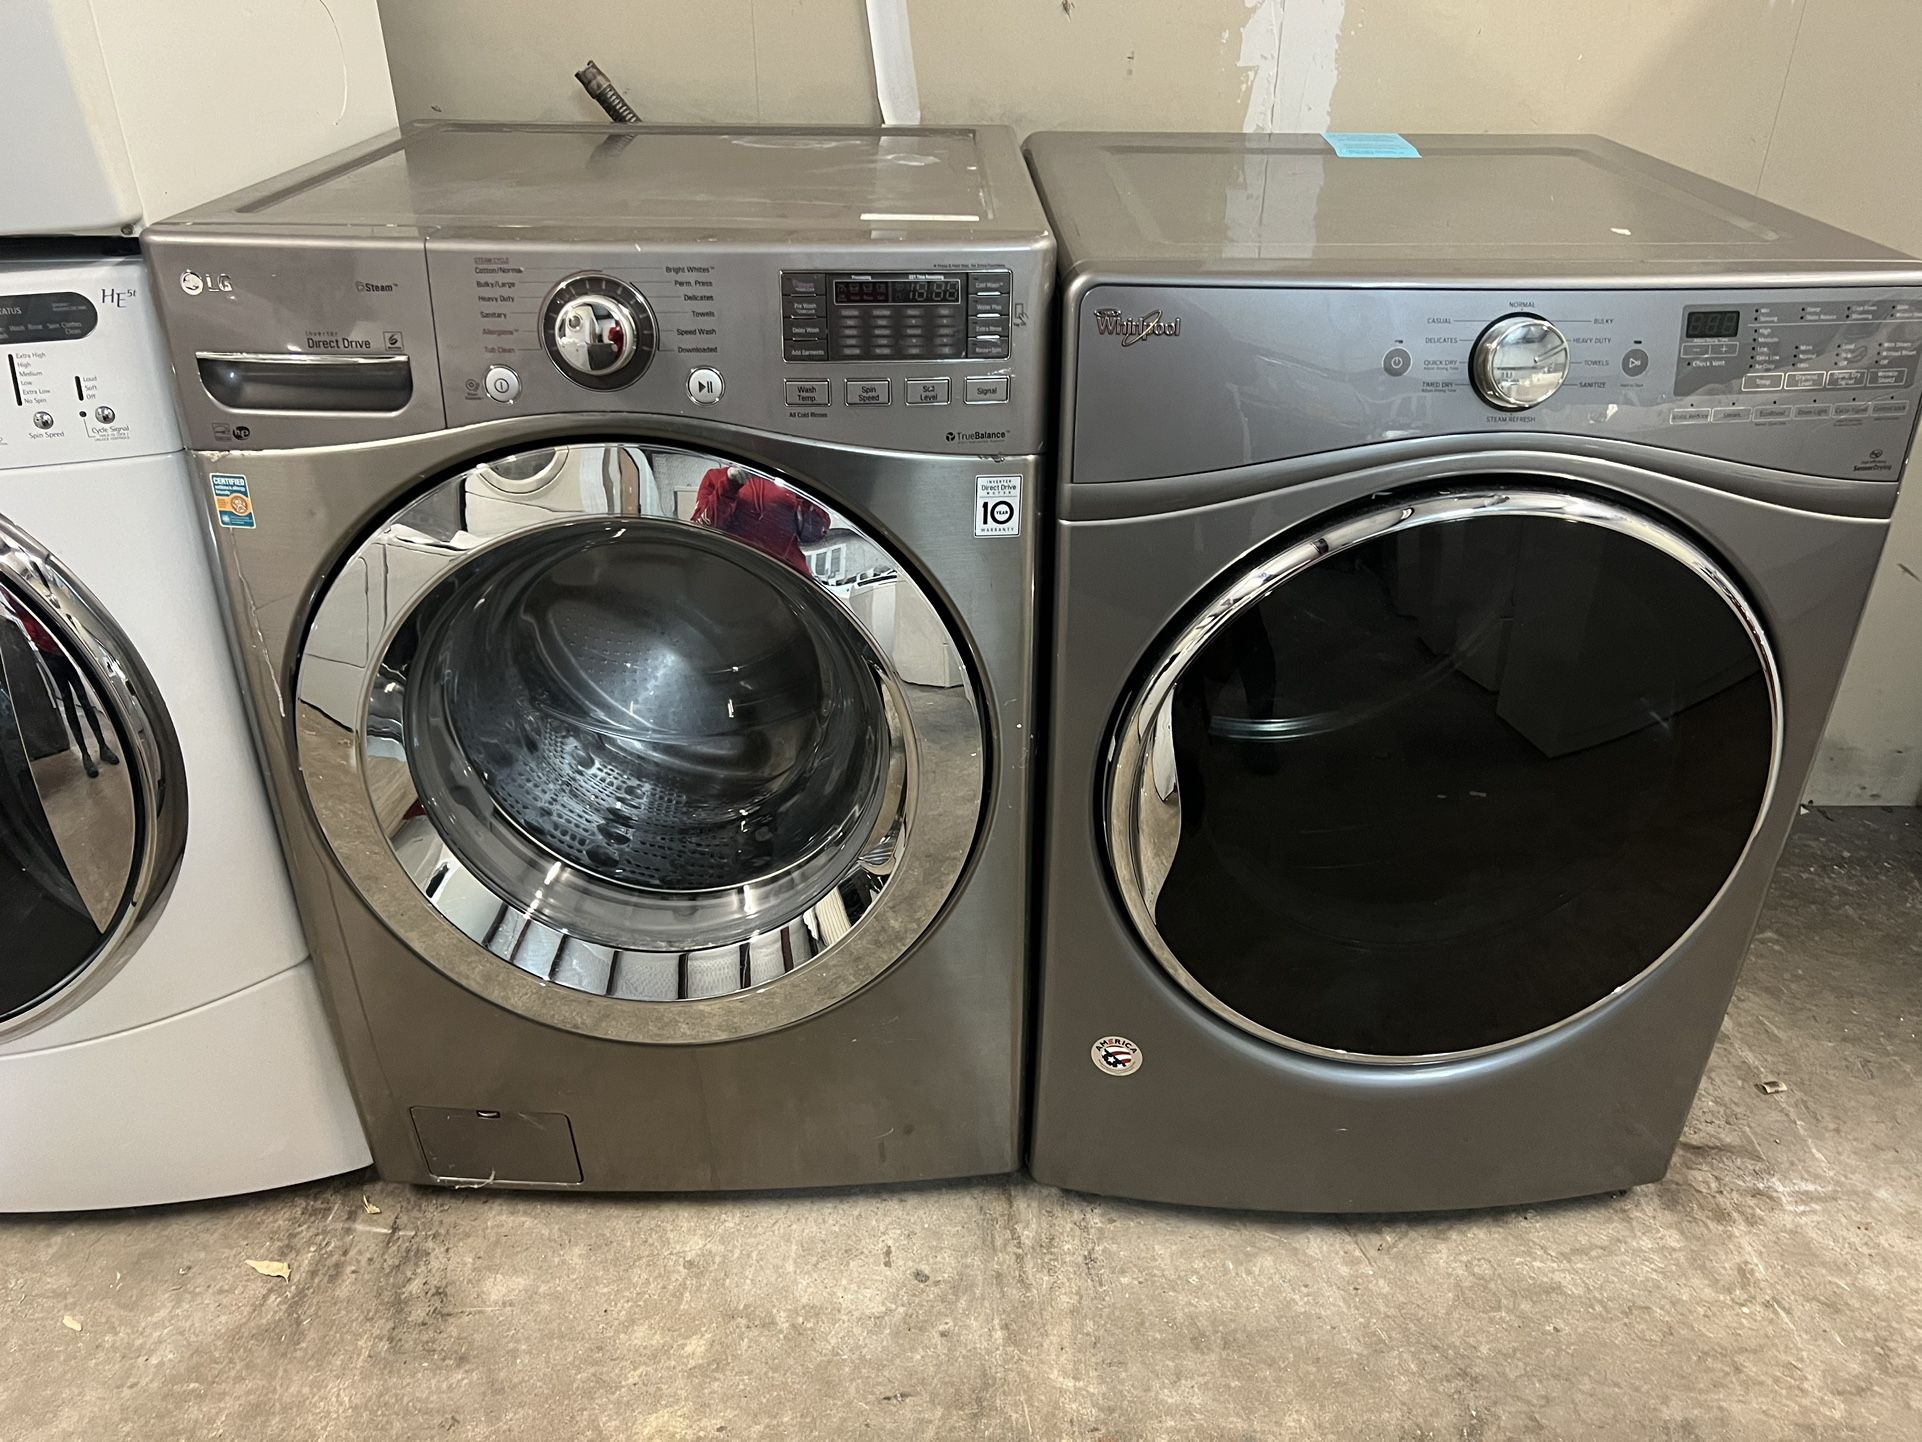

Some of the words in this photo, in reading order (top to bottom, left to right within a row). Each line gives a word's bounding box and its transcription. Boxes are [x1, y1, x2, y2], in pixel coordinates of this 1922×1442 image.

[666, 266, 685, 275] Bright
[206, 273, 233, 292] LG
[480, 311, 507, 319] Sanitary
[1094, 309, 1181, 341] Whirlpool
[307, 338, 340, 349] Direct
[343, 338, 371, 349] Drive
[32, 352, 46, 360] High
[861, 386, 876, 394] Spin
[977, 387, 997, 396] Signal
[34, 398, 47, 406] Spin
[858, 394, 879, 402] Speed
[110, 425, 130, 433] Signal
[29, 432, 44, 440] Spin
[45, 431, 65, 439] Speed
[213, 477, 245, 486] CERTIFIED
[982, 500, 1014, 525] 10
[1096, 1039, 1137, 1054] AMERICA
